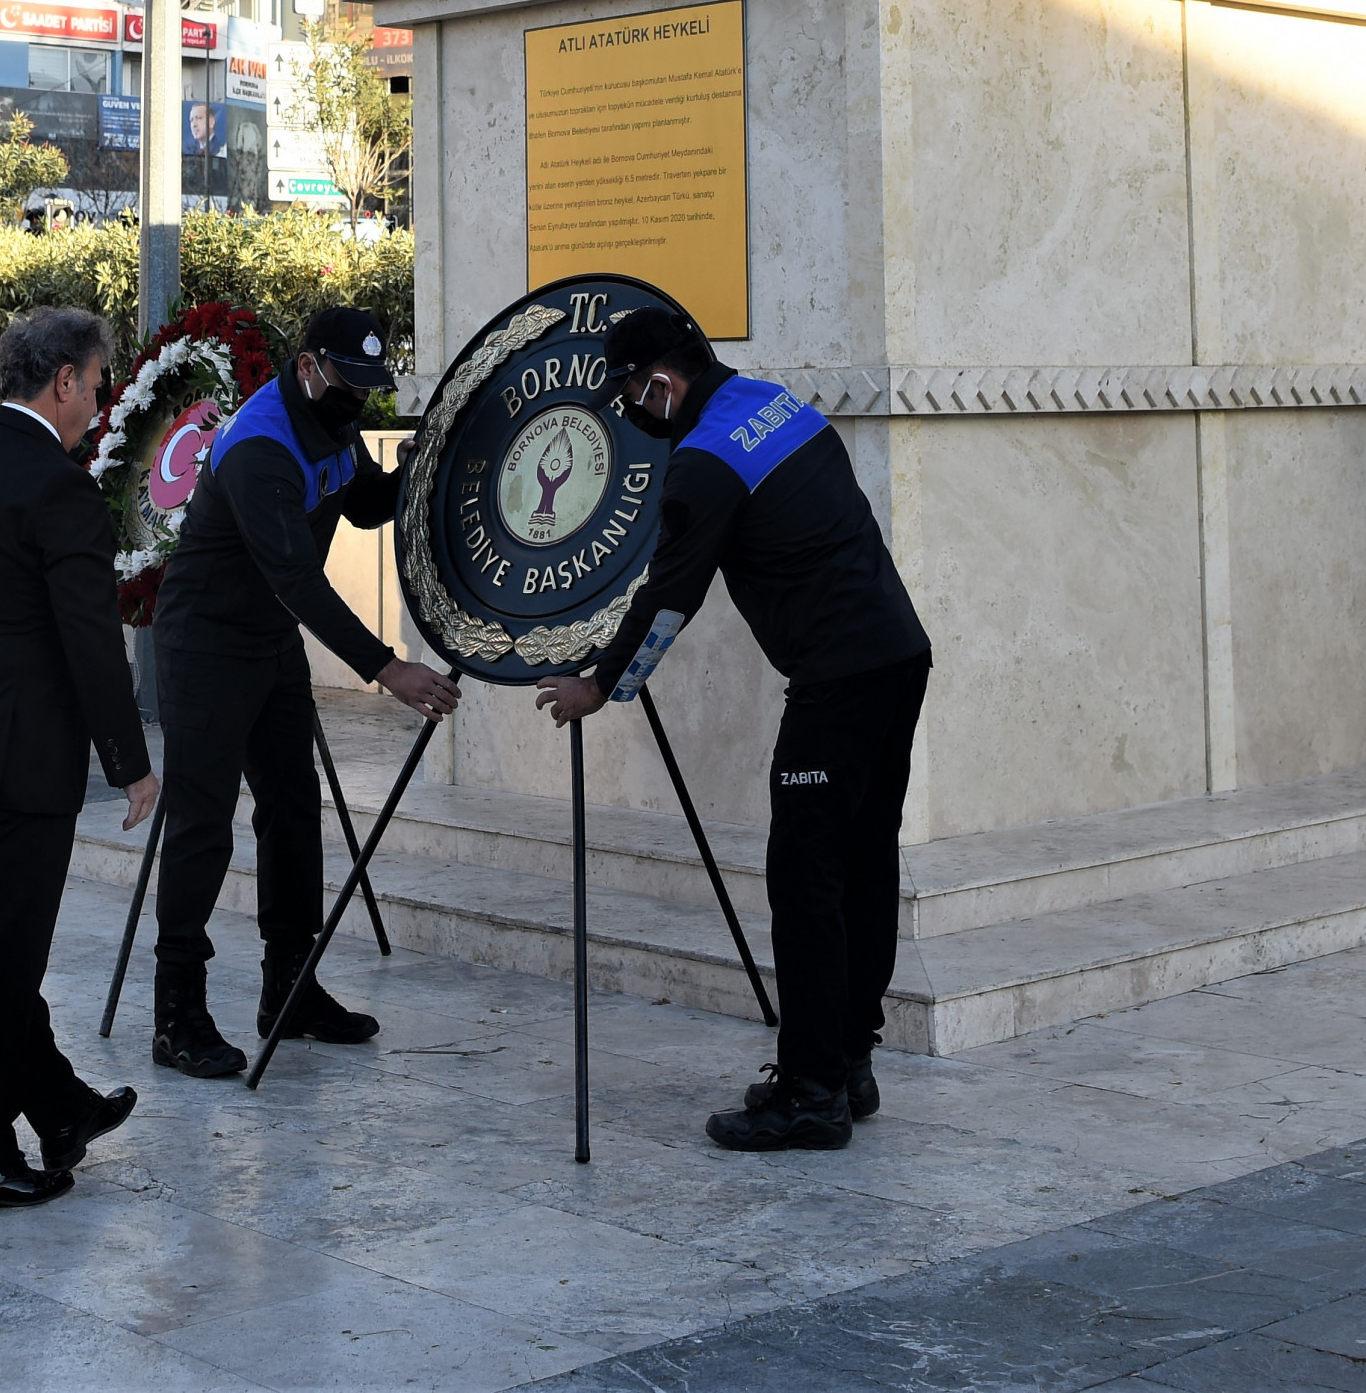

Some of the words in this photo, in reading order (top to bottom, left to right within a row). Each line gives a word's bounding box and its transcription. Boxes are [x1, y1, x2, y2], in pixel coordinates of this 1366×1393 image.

[22, 12, 68, 30] SAADET
[383, 30, 409, 46] 373
[558, 36, 585, 53] ATLI
[589, 26, 649, 49] ATATÜRK
[654, 15, 710, 40] HEYKELİ
[604, 81, 631, 90] kurucusu
[668, 72, 692, 83] Mustafa
[693, 69, 713, 79] Kemal
[635, 97, 664, 108] mücadele
[686, 92, 710, 102] kurtuluş
[547, 128, 570, 138] Bornova
[571, 125, 600, 136] Belediyesi
[550, 159, 570, 168] Atatürk
[571, 157, 591, 168] Heykeli
[611, 154, 635, 163] Bornova
[636, 150, 670, 161] Cumhuriyet
[663, 171, 692, 180] Traverten
[692, 168, 718, 179] yekpare
[718, 166, 727, 175] bir
[597, 197, 613, 206] bronz
[636, 193, 671, 204] Azerbaycan
[670, 213, 685, 222] 2020
[569, 292, 609, 334] T.C.
[508, 417, 558, 472] BORNOVA
[561, 416, 606, 476] BELEDİYESİ
[460, 459, 513, 587] BELEDİYE
[523, 463, 653, 594] BAŞKANLIĞI
[528, 528, 551, 540] 1881
[780, 770, 829, 785] ZABITA
